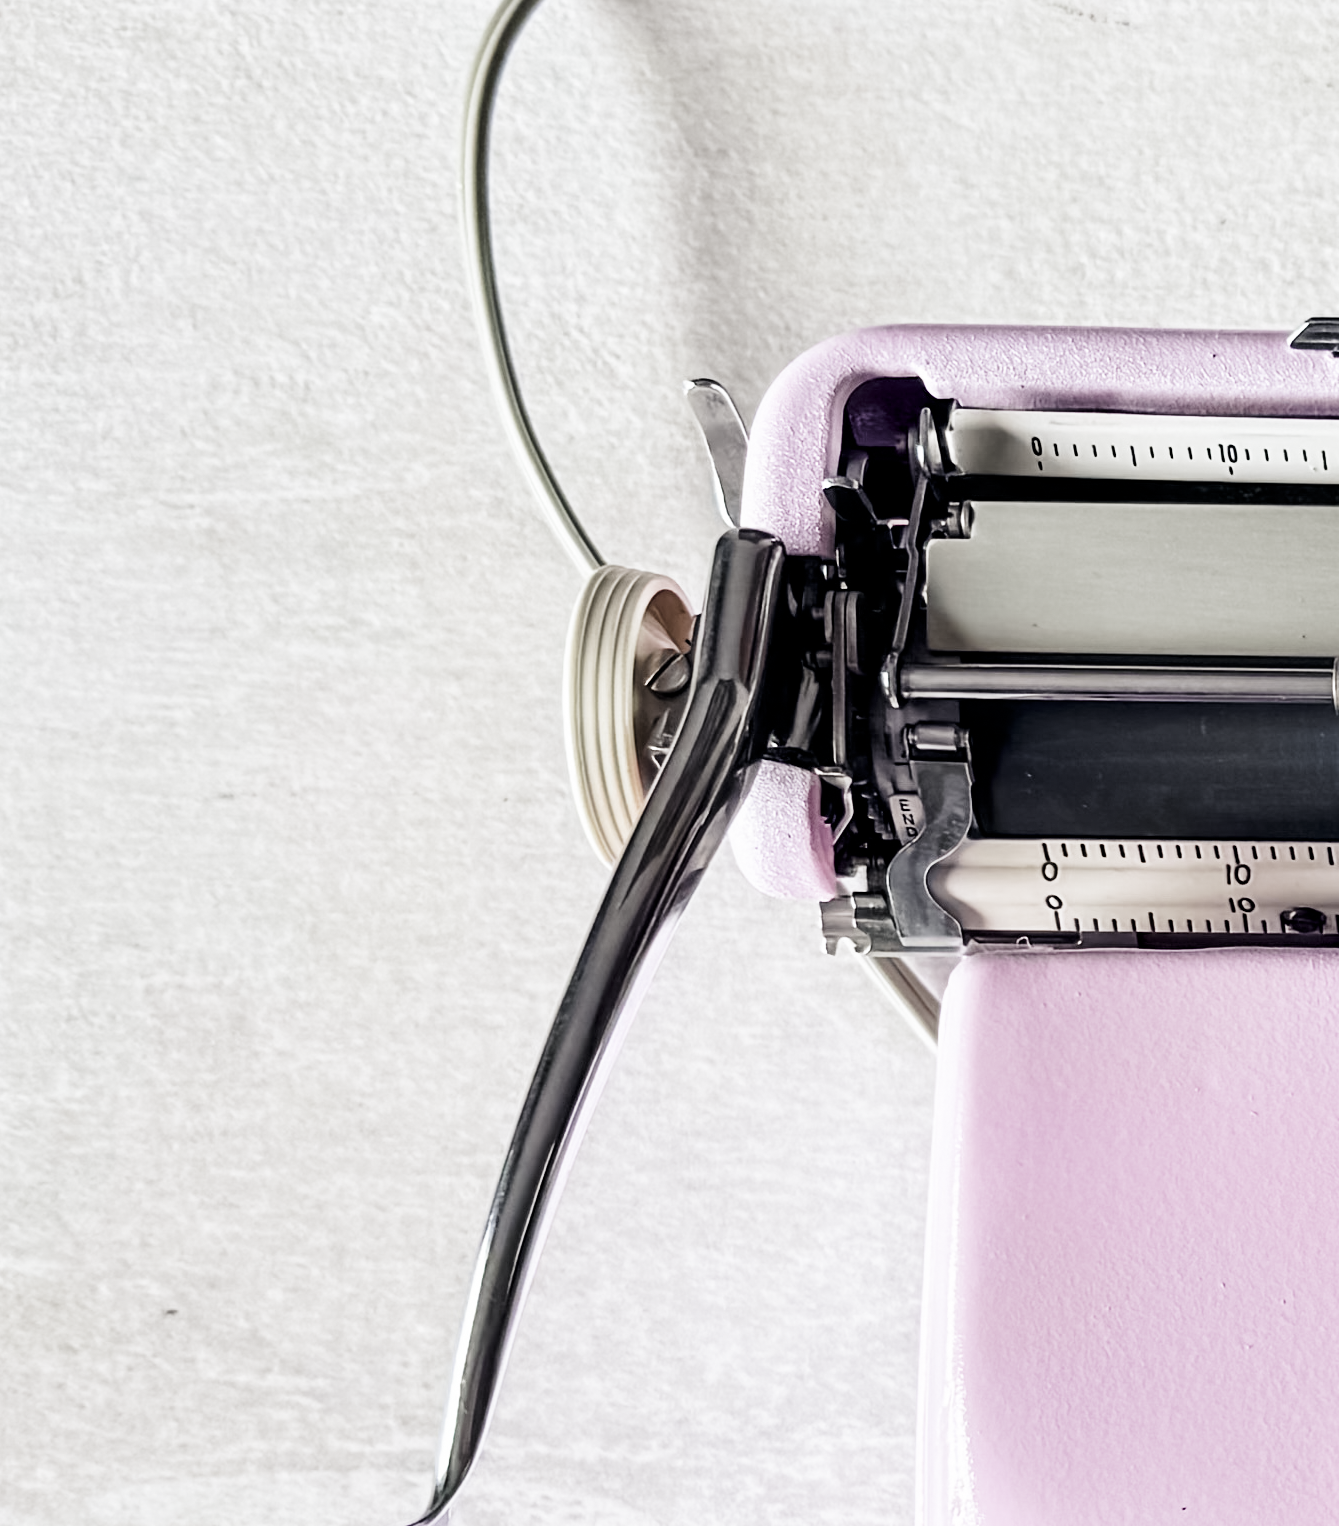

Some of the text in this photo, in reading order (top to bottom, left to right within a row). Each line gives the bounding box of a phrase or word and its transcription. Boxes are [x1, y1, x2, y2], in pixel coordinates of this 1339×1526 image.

[1031, 436, 1043, 457] 0
[1218, 443, 1238, 464] 10
[898, 798, 919, 839] END
[1041, 860, 1059, 882] 0
[1225, 864, 1251, 886] 10
[1045, 894, 1063, 910] 0
[1228, 897, 1256, 914] 10
